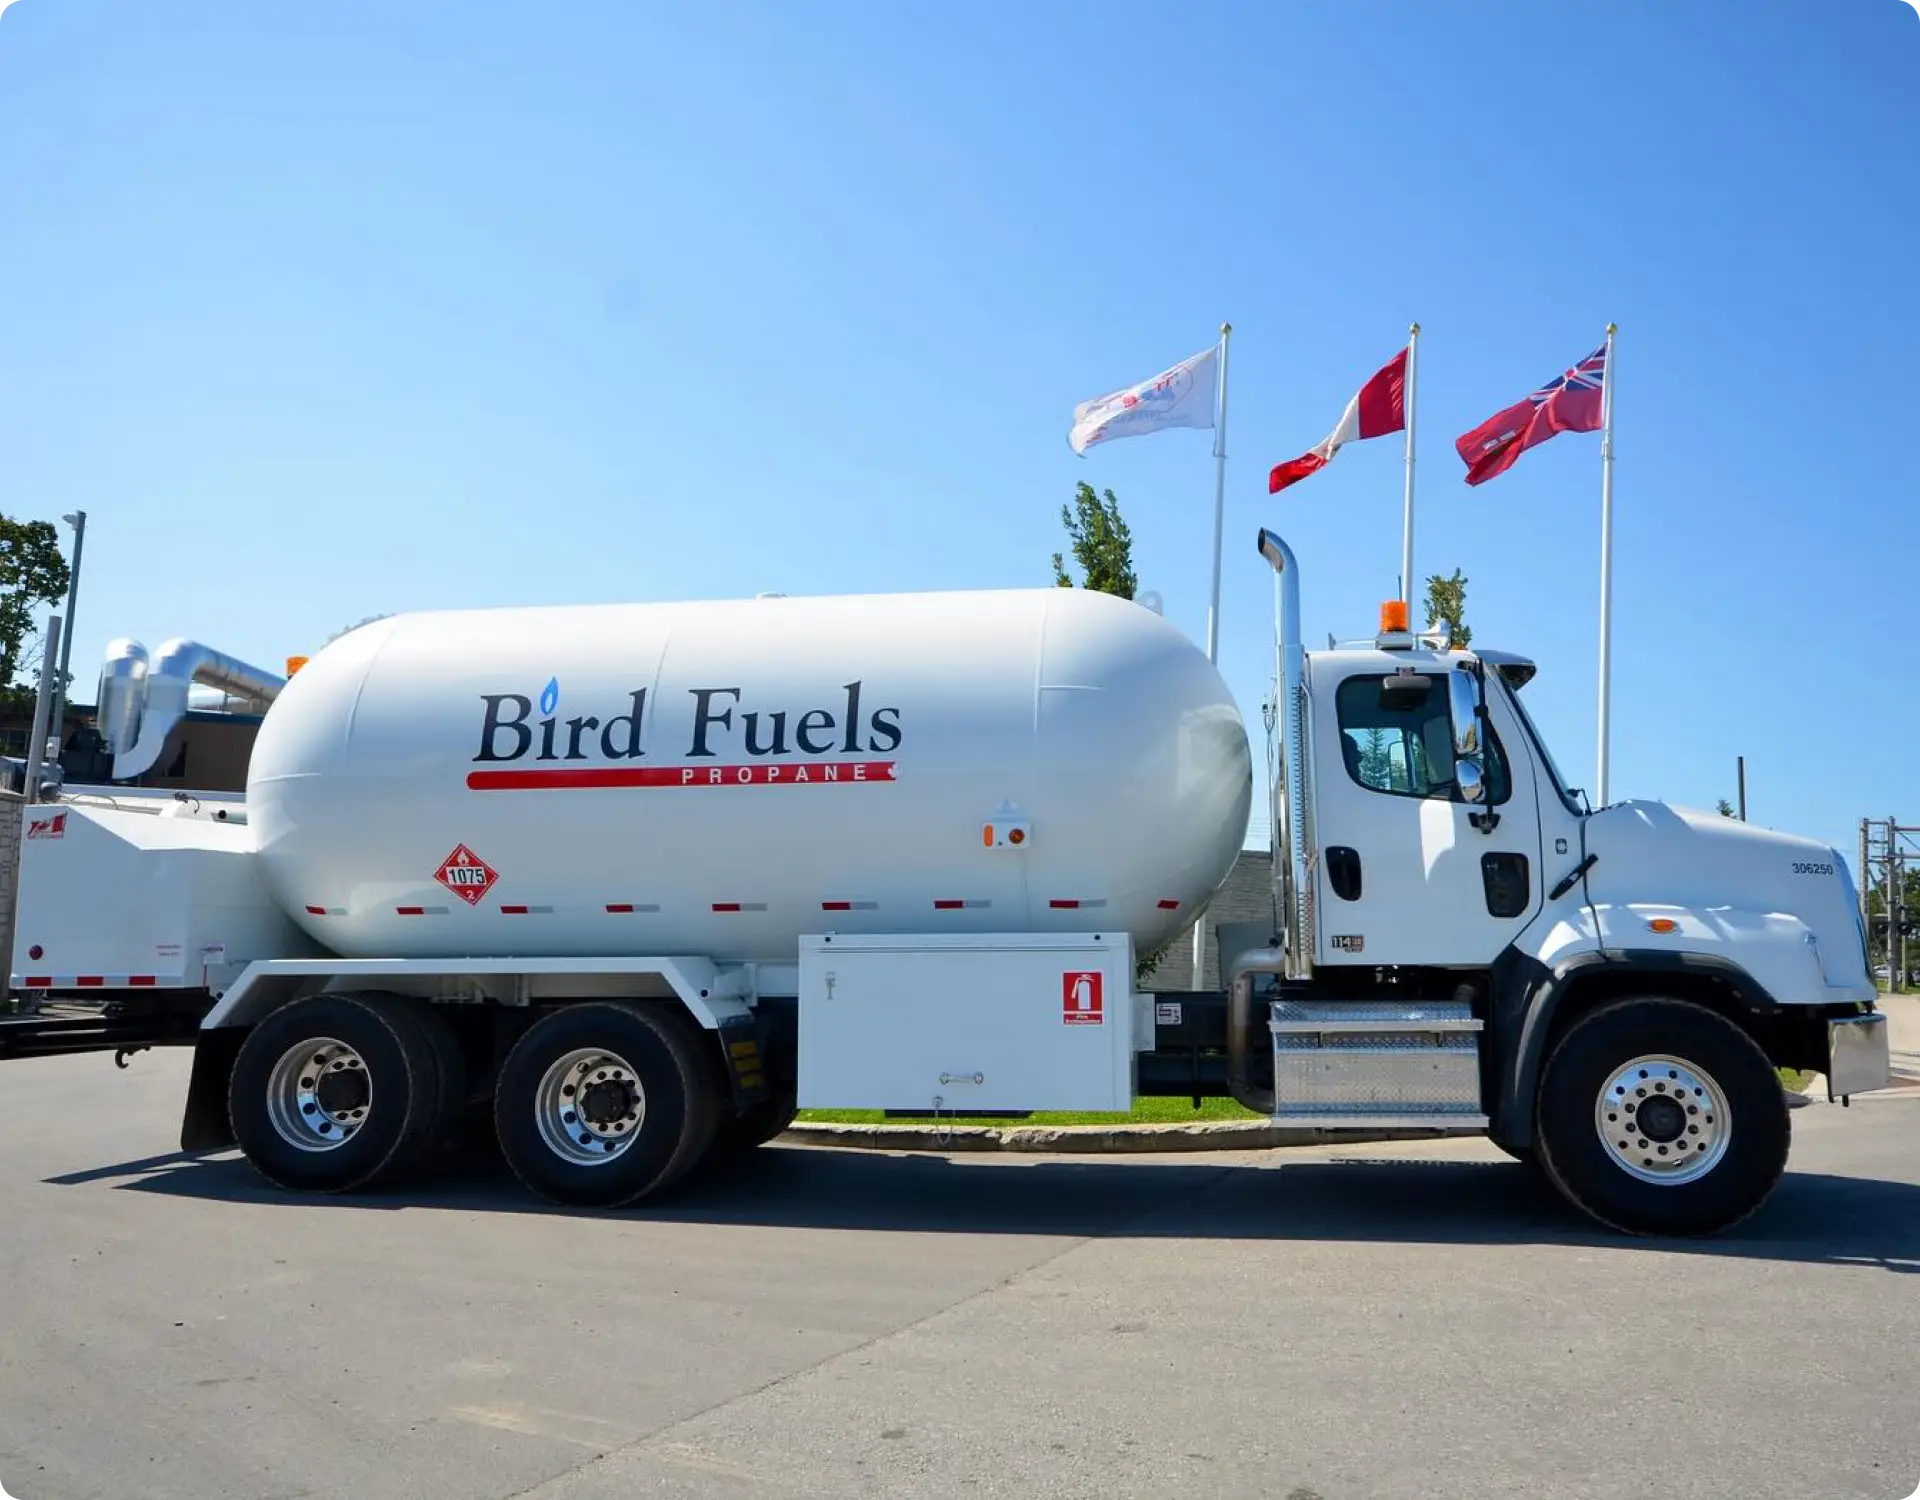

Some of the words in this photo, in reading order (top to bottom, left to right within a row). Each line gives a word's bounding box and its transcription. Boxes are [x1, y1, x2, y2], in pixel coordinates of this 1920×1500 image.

[472, 677, 647, 762] Bird
[685, 680, 902, 757] Fuels
[681, 764, 866, 785] PROPANE
[448, 868, 485, 884] 1075
[1791, 862, 1834, 875] 306250
[466, 889, 476, 900] 2
